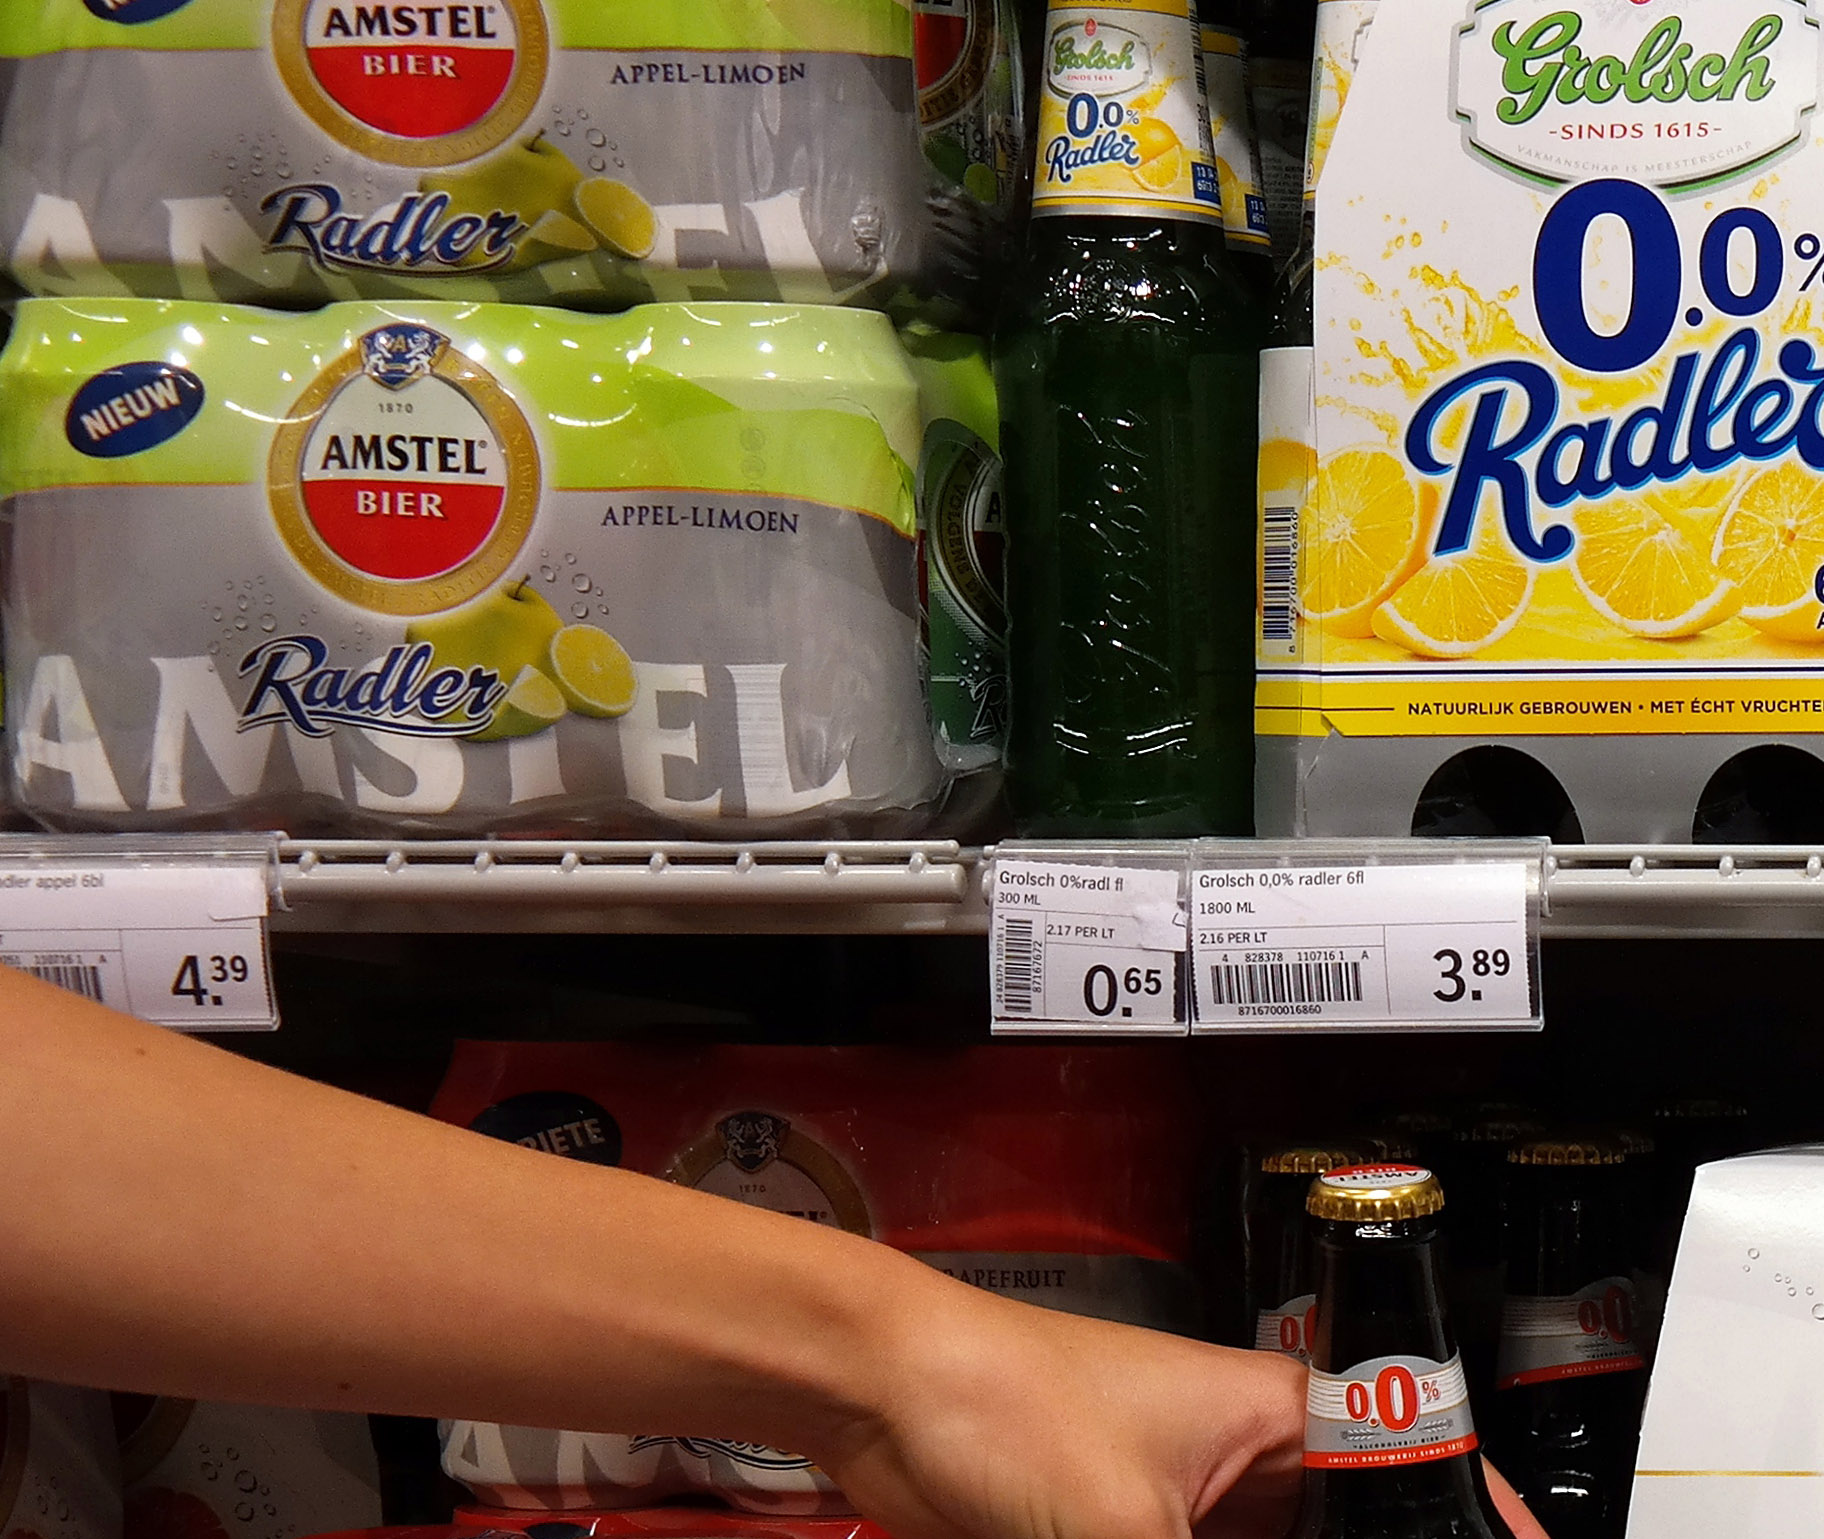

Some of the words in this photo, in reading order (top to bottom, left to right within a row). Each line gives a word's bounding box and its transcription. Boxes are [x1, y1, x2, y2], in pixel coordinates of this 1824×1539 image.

[610, 61, 805, 86] APPEL-LIMOEN
[1493, 9, 1784, 125] Grolsch
[1046, 131, 1140, 183] Radler
[80, 377, 182, 442] NIEUW
[321, 434, 488, 475] AMSTEL
[355, 490, 445, 519] BIER
[601, 505, 800, 534] APPEL-LIMOEN
[237, 634, 506, 734] Radler
[1408, 701, 1515, 716] NATUURLIJK
[1520, 701, 1632, 715] GEBROUWEN
[1651, 700, 1685, 714] MET
[1691, 696, 1735, 714] ÉCHT
[36, 875, 76, 890] appel
[1199, 871, 1255, 890] Grolsch
[1259, 871, 1294, 890] 0,0%
[1298, 871, 1342, 888] radler
[171, 955, 248, 1006] 4.39
[1083, 964, 1163, 1018] 0.65
[1433, 948, 1511, 1002] 3.89
[1344, 1362, 1440, 1433] 0.0%
